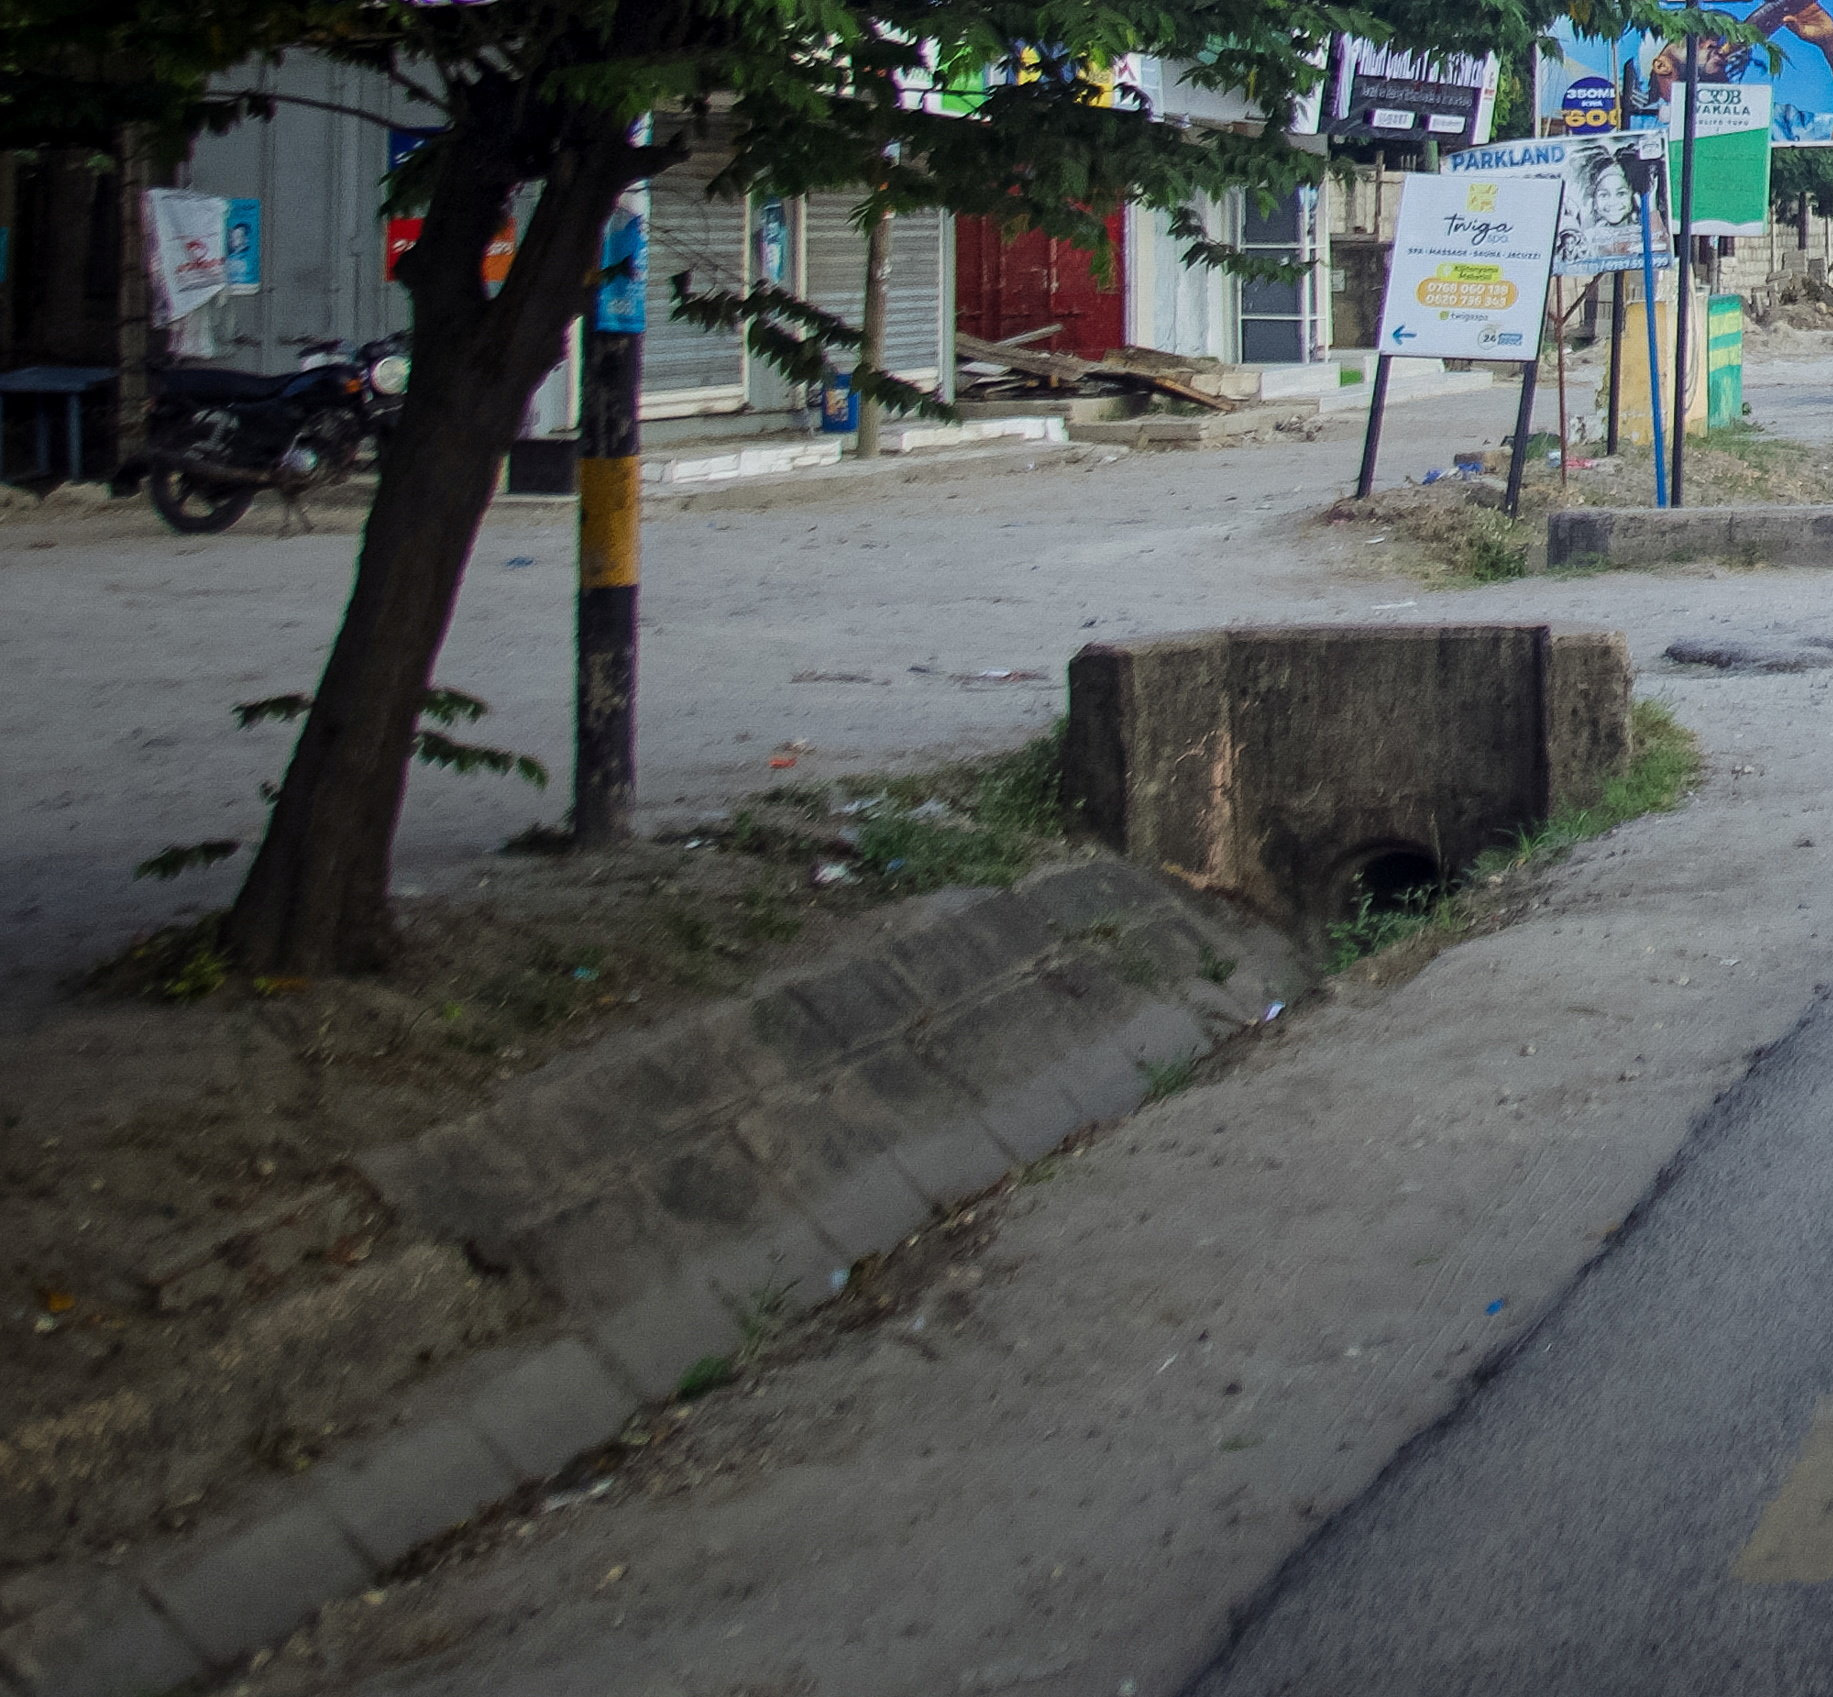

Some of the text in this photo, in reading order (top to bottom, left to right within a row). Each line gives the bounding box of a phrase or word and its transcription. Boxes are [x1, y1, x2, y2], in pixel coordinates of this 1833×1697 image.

[1452, 144, 1566, 173] PARKLAND
[1443, 213, 1514, 246] twiga
[1429, 247, 1467, 257] MASSAGE
[1473, 250, 1500, 258] SAUNA
[1507, 251, 1541, 259] JACUZZI
